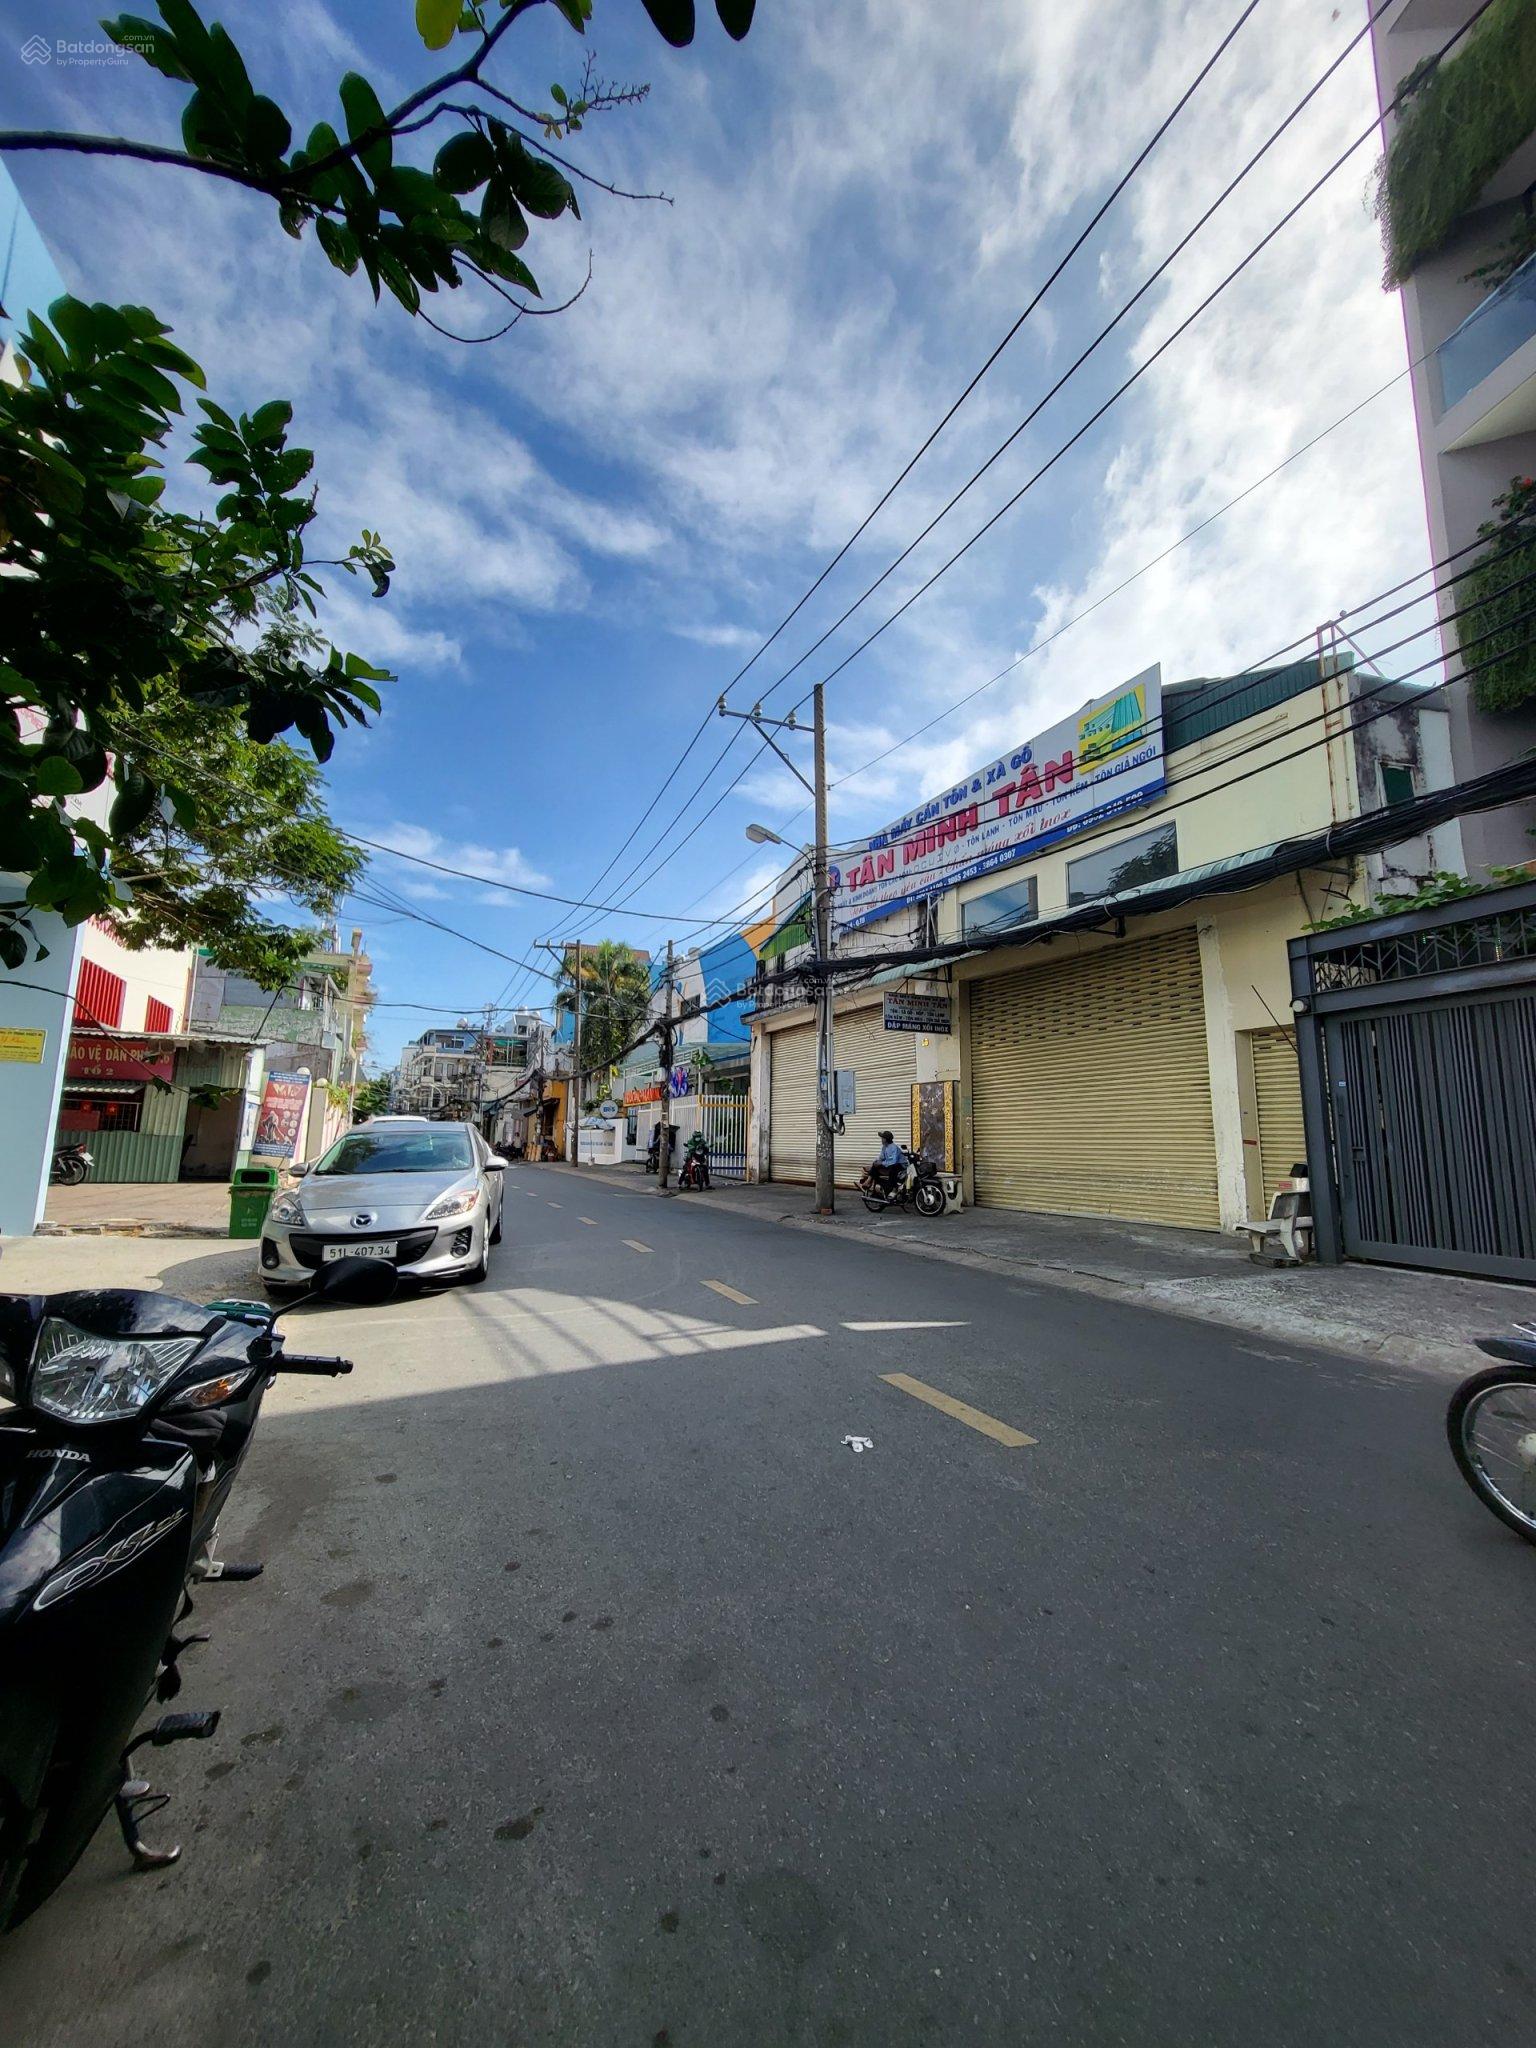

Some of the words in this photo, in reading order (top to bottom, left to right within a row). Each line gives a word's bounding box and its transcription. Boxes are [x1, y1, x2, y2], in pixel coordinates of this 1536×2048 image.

[891, 816, 913, 840] MÁY
[915, 802, 940, 824] CÁN
[943, 784, 968, 809] TÔN
[971, 778, 983, 793] &
[986, 761, 1007, 786] XÀ
[966, 834, 980, 848] TÔN
[1114, 755, 1131, 773] GIẢ
[845, 849, 895, 893] TÂN
[902, 801, 979, 866] MINH
[991, 749, 1074, 817] TÂN
[887, 996, 905, 1005] TÂN
[907, 999, 929, 1008] MINH
[931, 1001, 948, 1009] TÂN
[70, 1042, 86, 1060] ẢO
[88, 1044, 102, 1063] VỆ
[105, 1045, 127, 1062] DÂN
[105, 1067, 114, 1076] 2
[329, 1245, 391, 1259] 51L-407.34
[25, 1448, 92, 1463] HONDA
